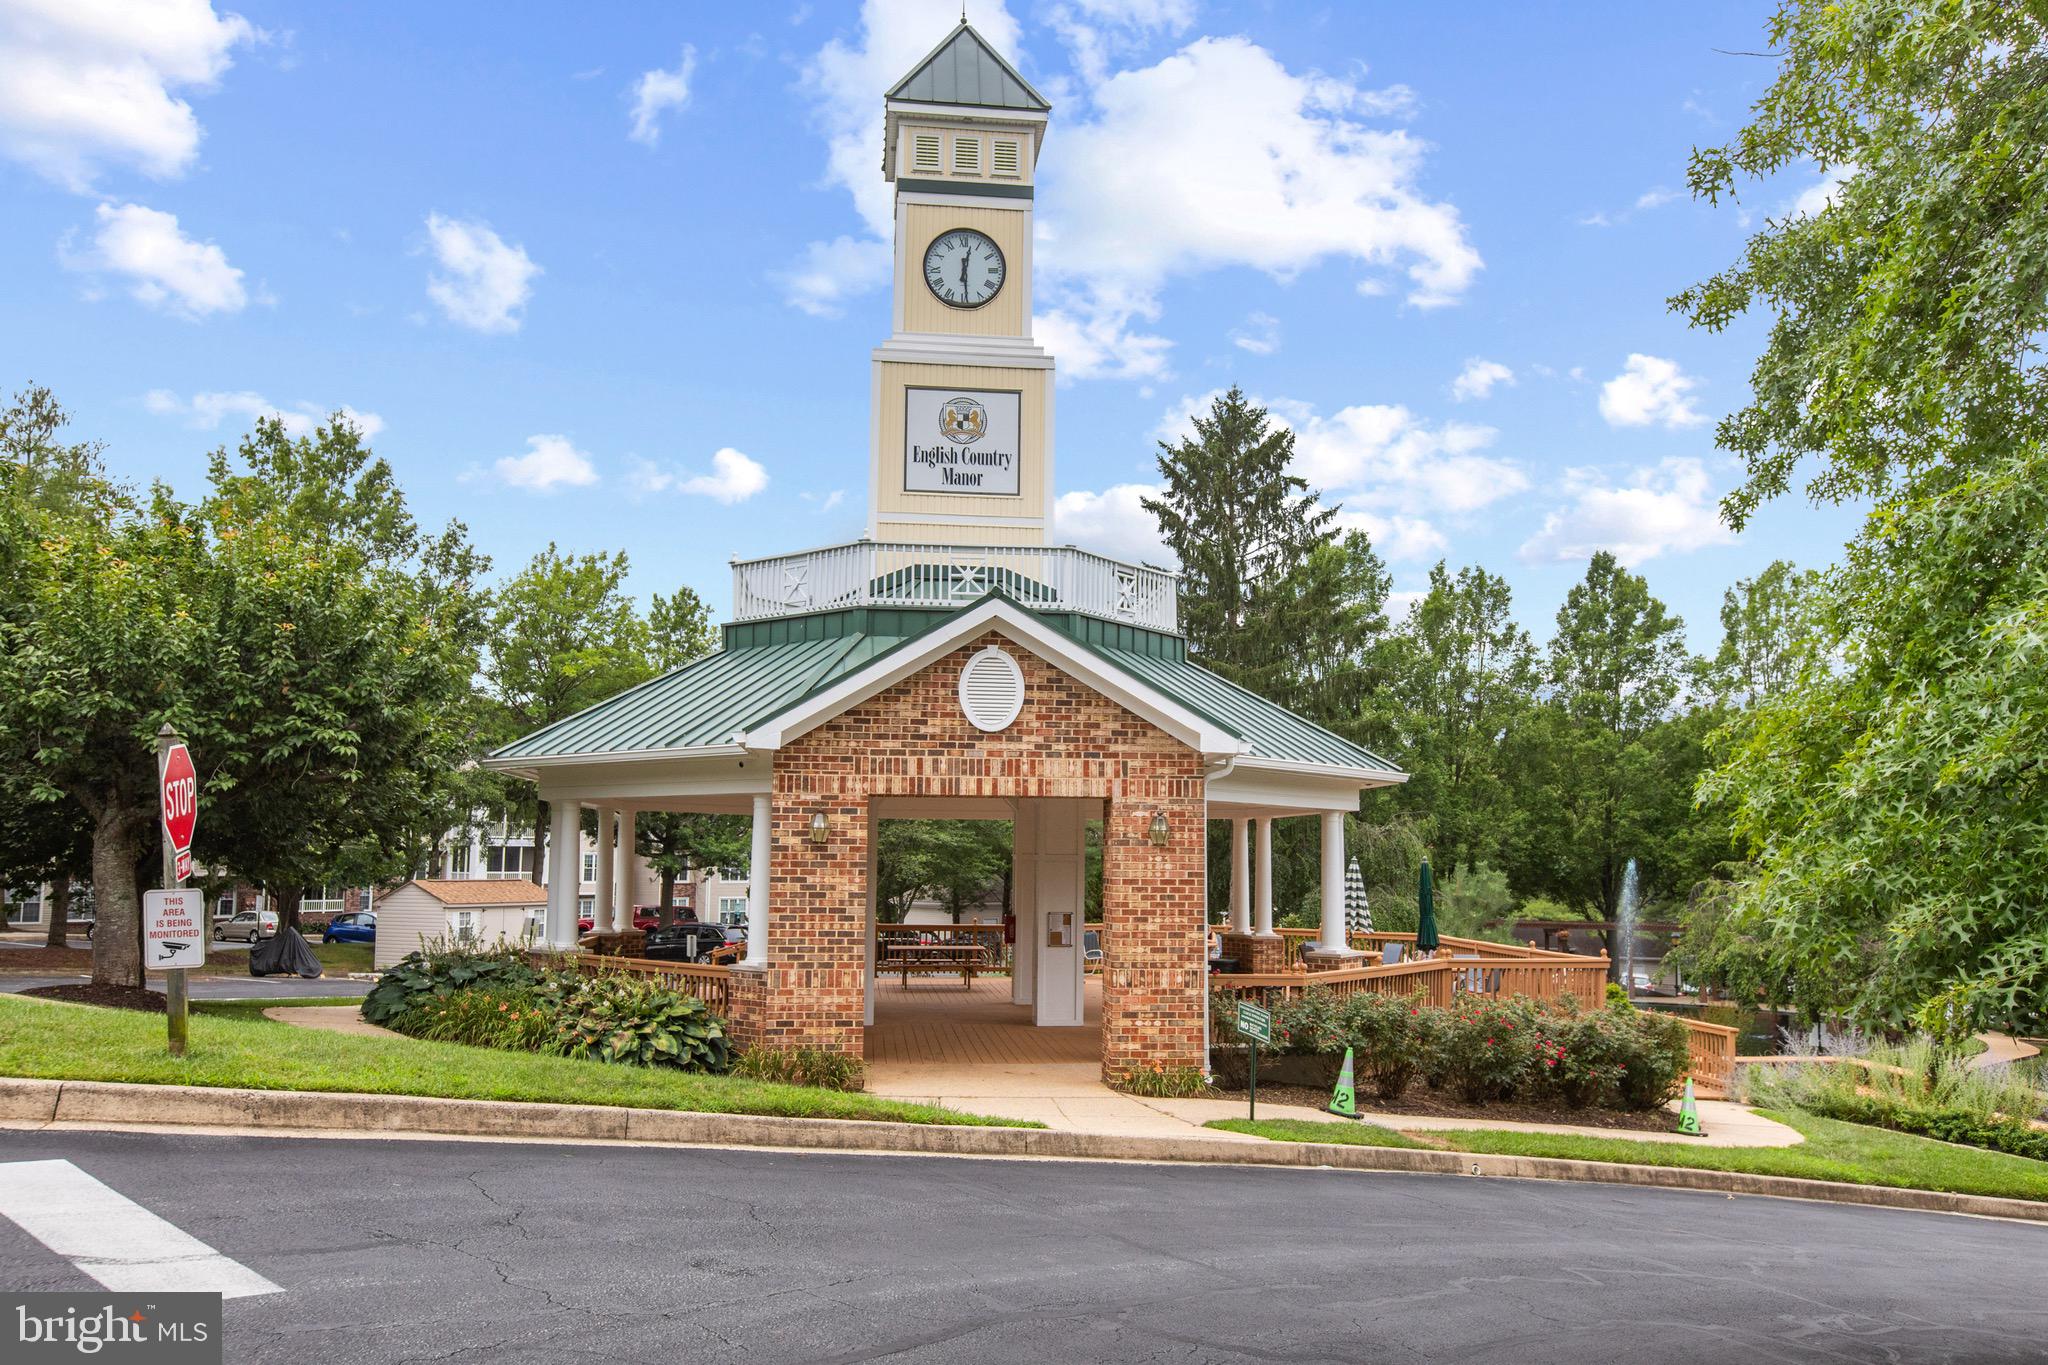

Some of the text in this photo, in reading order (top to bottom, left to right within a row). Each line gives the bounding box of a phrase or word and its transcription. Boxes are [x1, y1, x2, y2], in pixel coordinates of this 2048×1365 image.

[912, 445, 1012, 472] English Country
[941, 467, 984, 487] Manor
[166, 777, 194, 820] STOP
[164, 897, 184, 905] THIS
[163, 908, 185, 916] AREA
[156, 919, 192, 928] IS BEING
[149, 929, 200, 939] MONITORED
